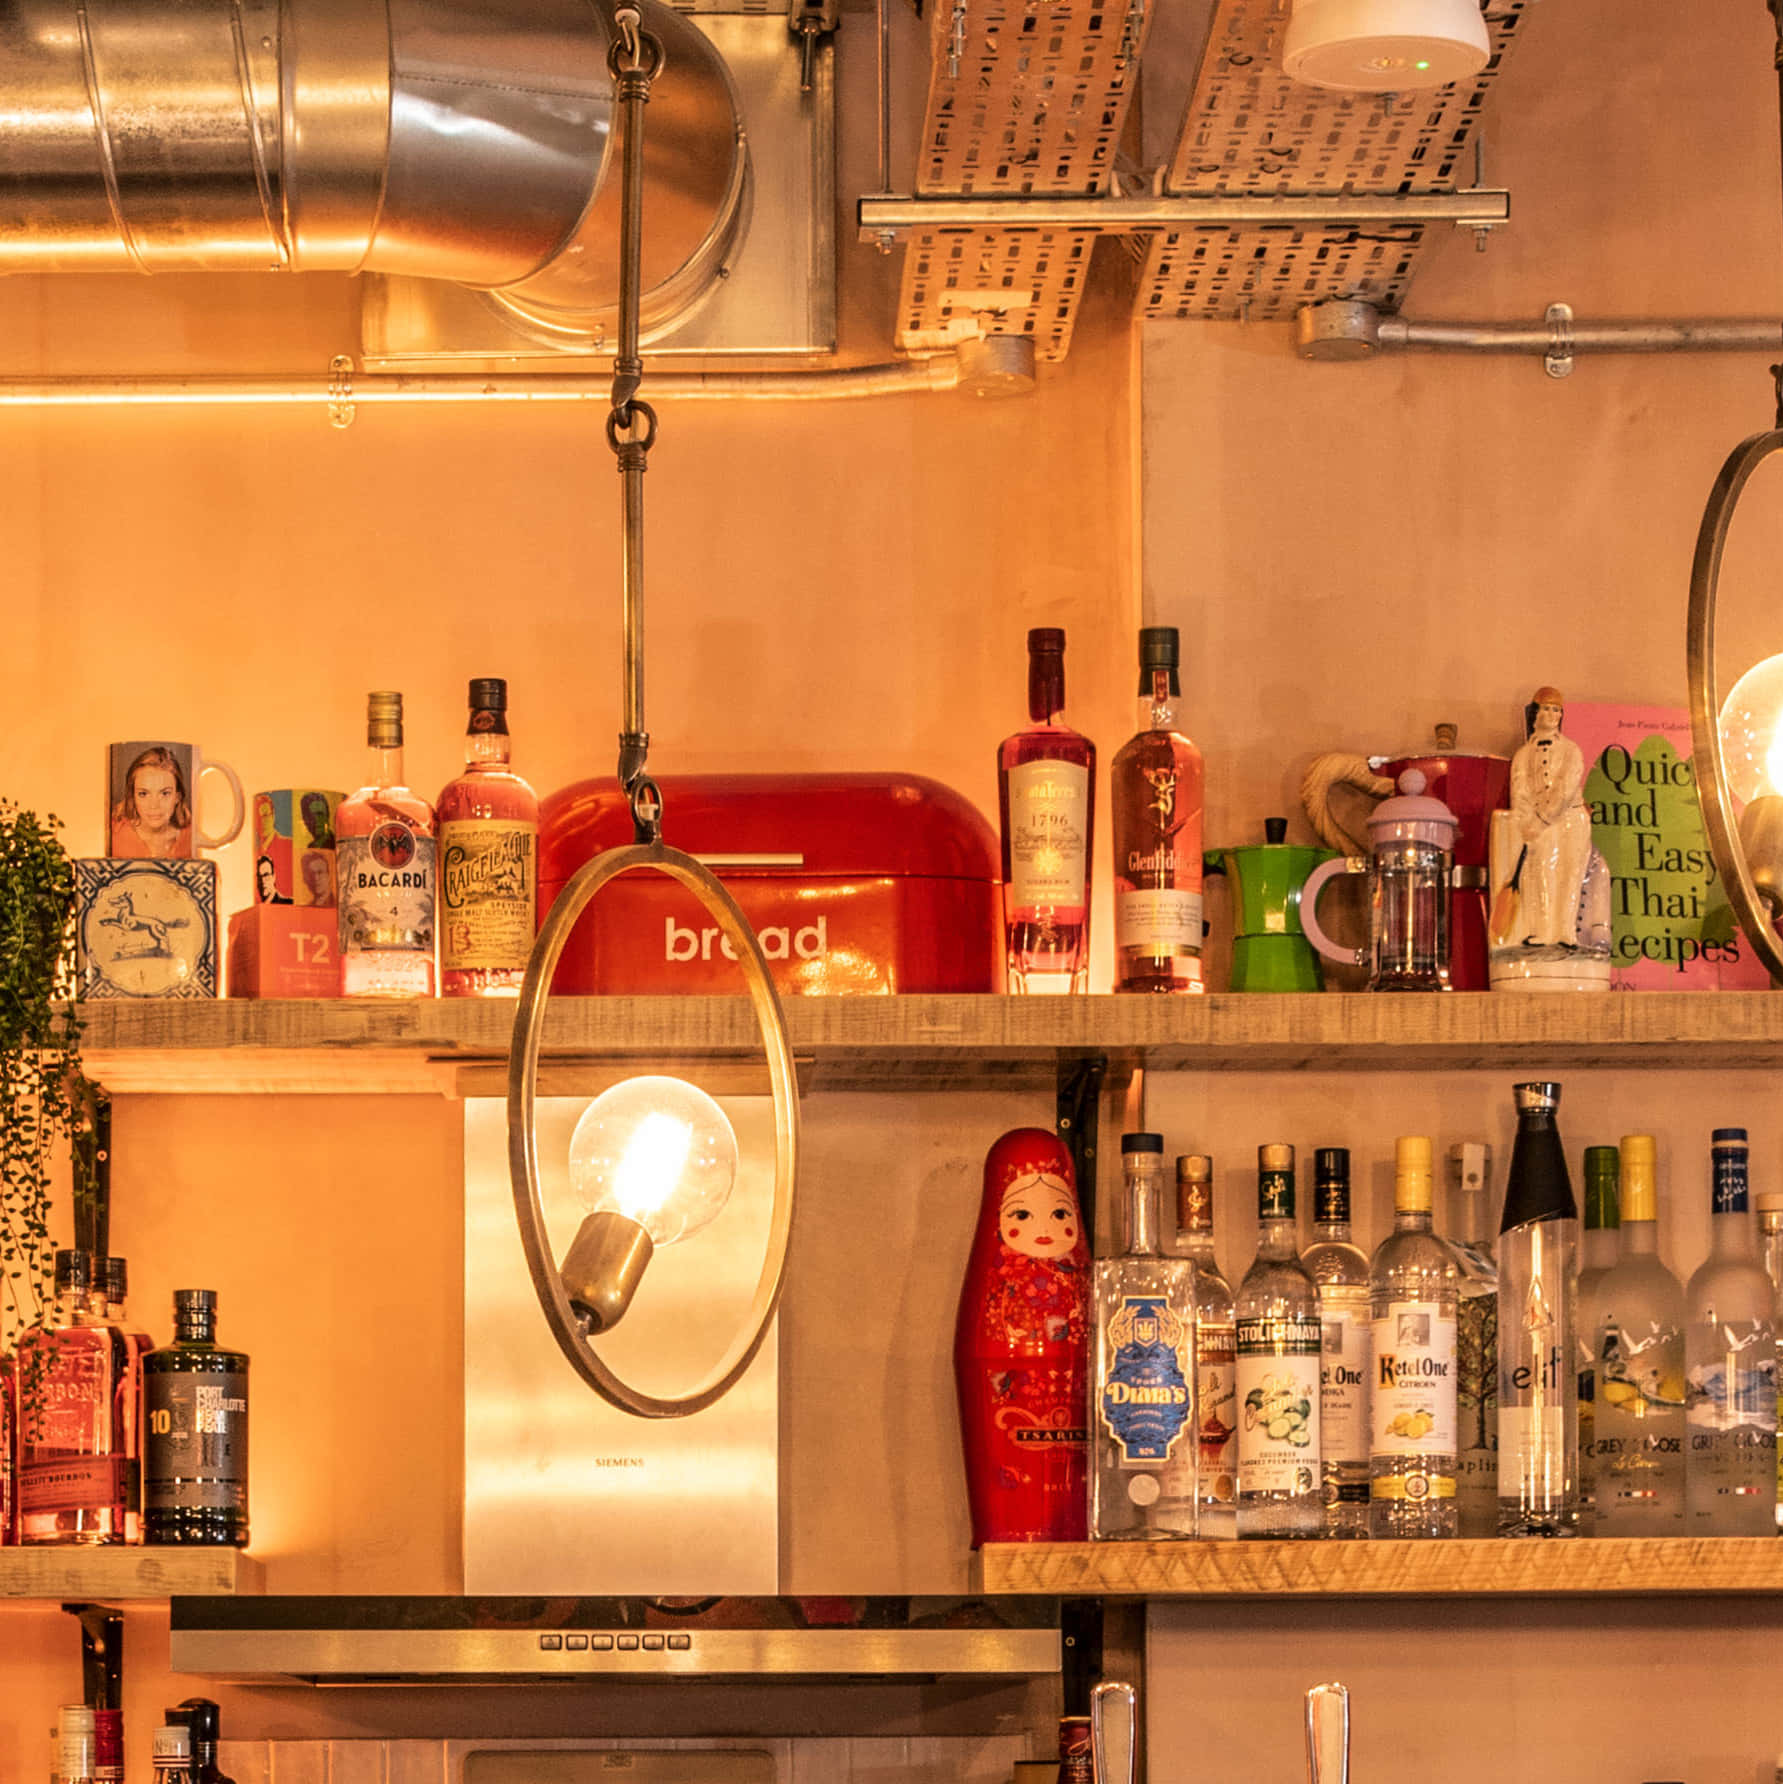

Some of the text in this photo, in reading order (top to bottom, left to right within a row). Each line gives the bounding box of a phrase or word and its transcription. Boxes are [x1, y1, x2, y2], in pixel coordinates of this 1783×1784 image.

[1600, 744, 1696, 795] Quic
[1031, 813, 1069, 827] 1796
[1590, 788, 1659, 827] and
[1634, 832, 1716, 886] Easy
[357, 869, 427, 889] BACARDÍ
[1610, 876, 1701, 920] Thai
[290, 932, 330, 964] T2
[448, 924, 472, 953] 13
[1335, 1368, 1362, 1385] One
[1379, 1354, 1449, 1388] Ketel One
[1105, 1381, 1187, 1405] Dima's
[150, 1408, 171, 1434] 10
[1597, 1438, 1625, 1454] GREY
[595, 1457, 645, 1467] SIEMENS
